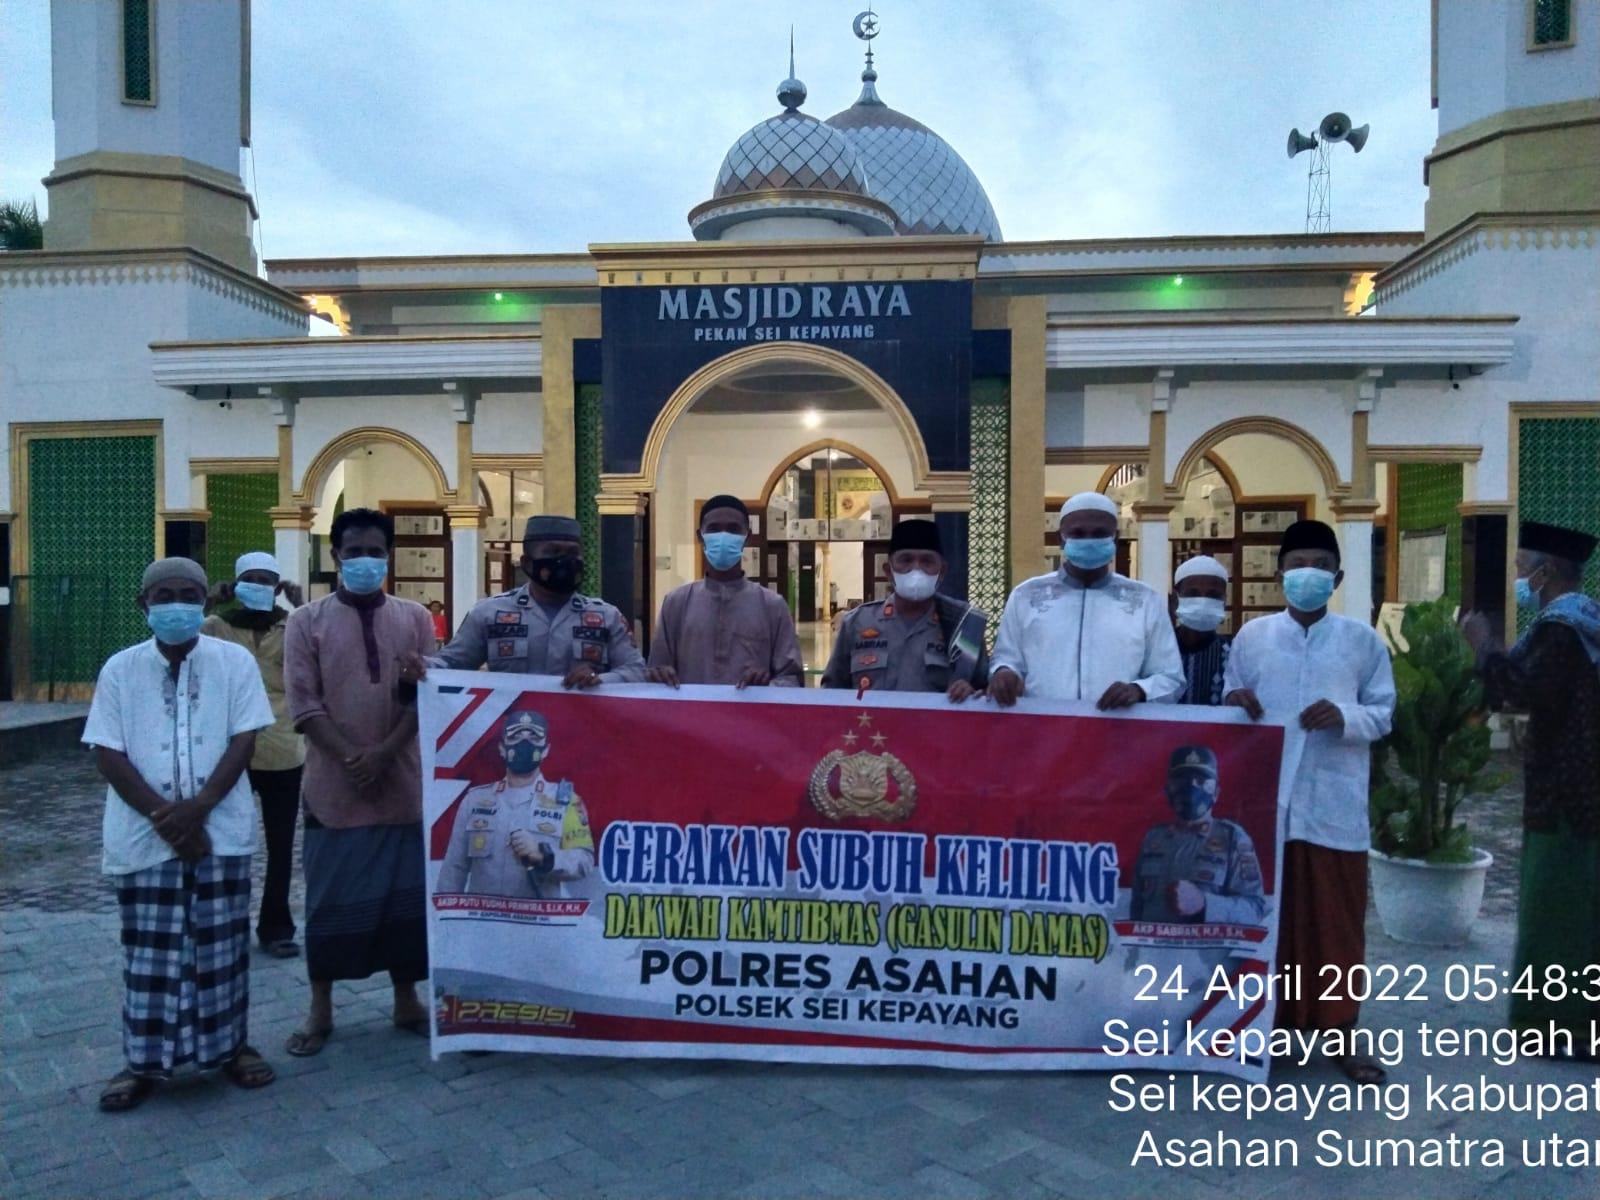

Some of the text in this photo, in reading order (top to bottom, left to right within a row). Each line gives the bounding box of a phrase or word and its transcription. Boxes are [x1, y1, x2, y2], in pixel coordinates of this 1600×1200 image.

[658, 285, 912, 327] MASJID RAYA
[694, 324, 875, 342] PEKAN SEI KEPAYANG
[602, 823, 1119, 905] GERAKAN SUBUH KELILING
[603, 893, 1110, 964] DAKWAH KAMTIBMAS (GASULIN DAMAS)
[1132, 924, 1154, 935] AKP
[640, 949, 1057, 1002] POLRES ASAHAN
[675, 994, 1019, 1030] POLSEK SEI KEPAYANG
